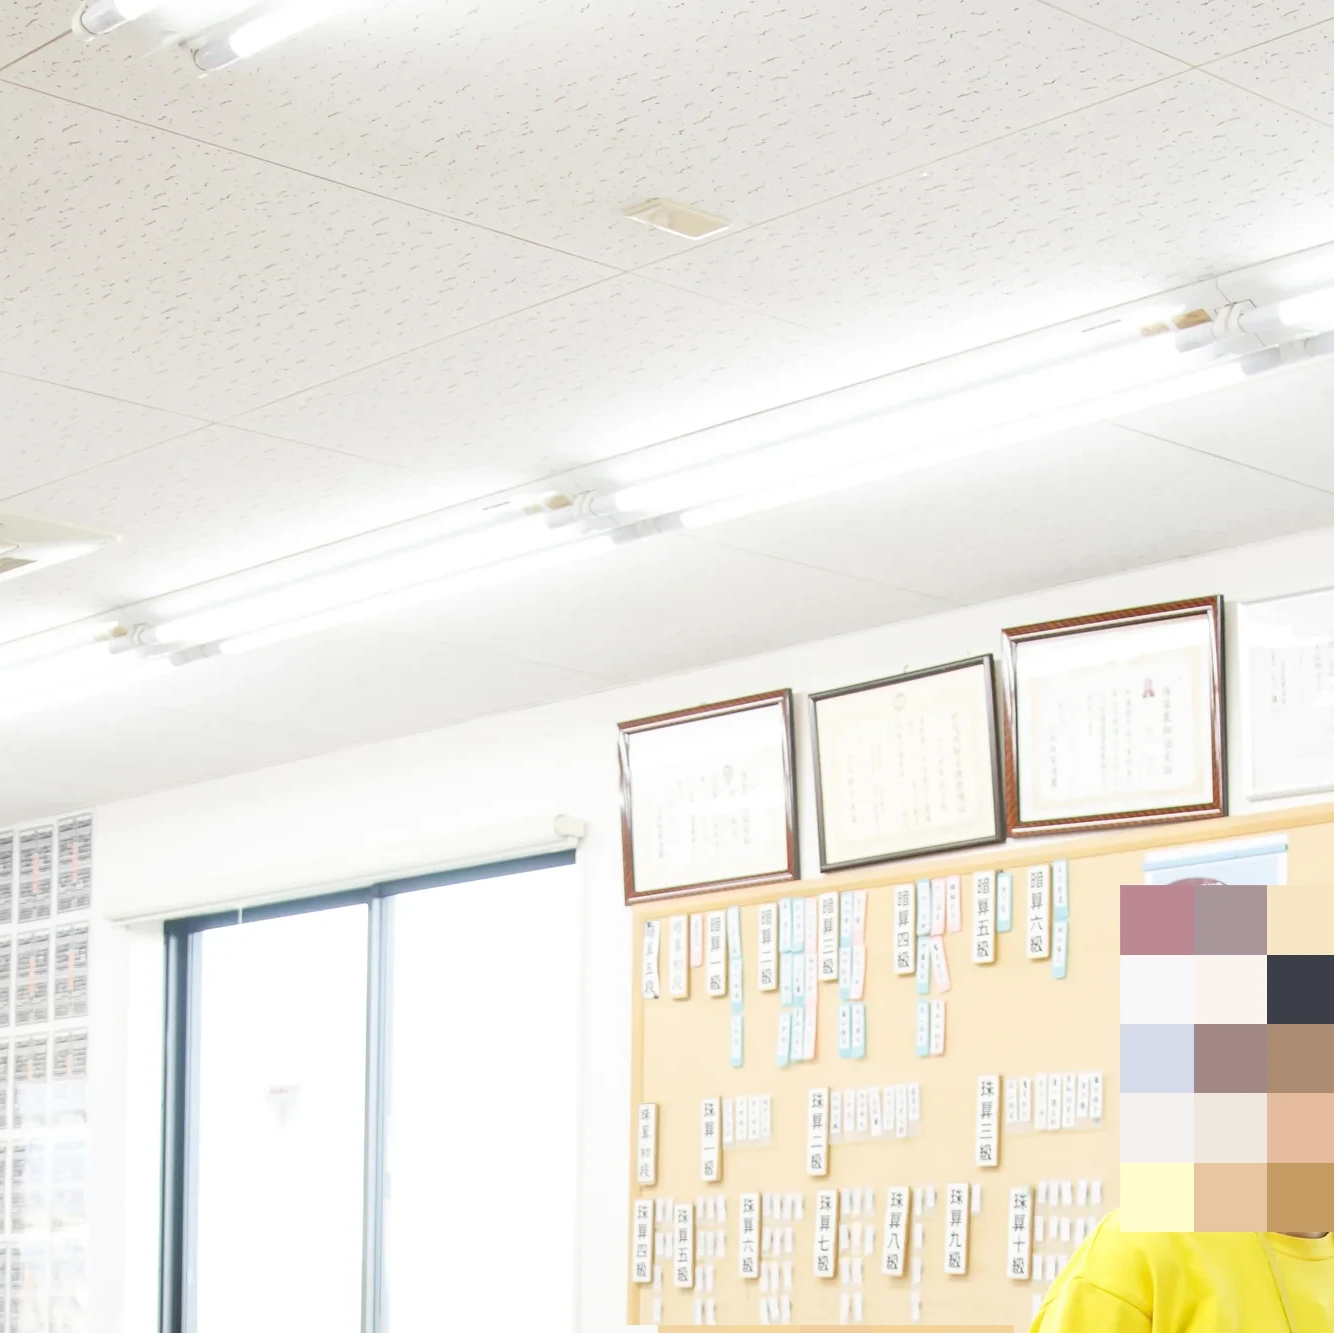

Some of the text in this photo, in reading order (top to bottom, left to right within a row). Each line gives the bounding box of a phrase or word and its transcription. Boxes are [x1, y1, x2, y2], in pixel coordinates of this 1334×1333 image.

[760, 909, 772, 985] 暗算二級
[823, 898, 834, 974] 暗算三級
[897, 890, 910, 969] 暗算四級
[977, 877, 990, 958] 暗算五級
[1030, 871, 1044, 953] 暗算六級
[710, 916, 721, 991] 暗算一級
[704, 1102, 716, 1176] 珠算一級
[810, 1093, 823, 1170] 珠算二級
[979, 1080, 994, 1161] 珠算三級
[636, 1205, 648, 1278] 珠算四級
[677, 1209, 689, 1282] 珠算五級
[742, 1197, 755, 1273] 珠算六級
[817, 1195, 831, 1272] 珠算七級
[886, 1191, 903, 1270] 珠算八級
[948, 1189, 963, 1268] 珠算九級
[1012, 1192, 1027, 1274] 珠算十級
